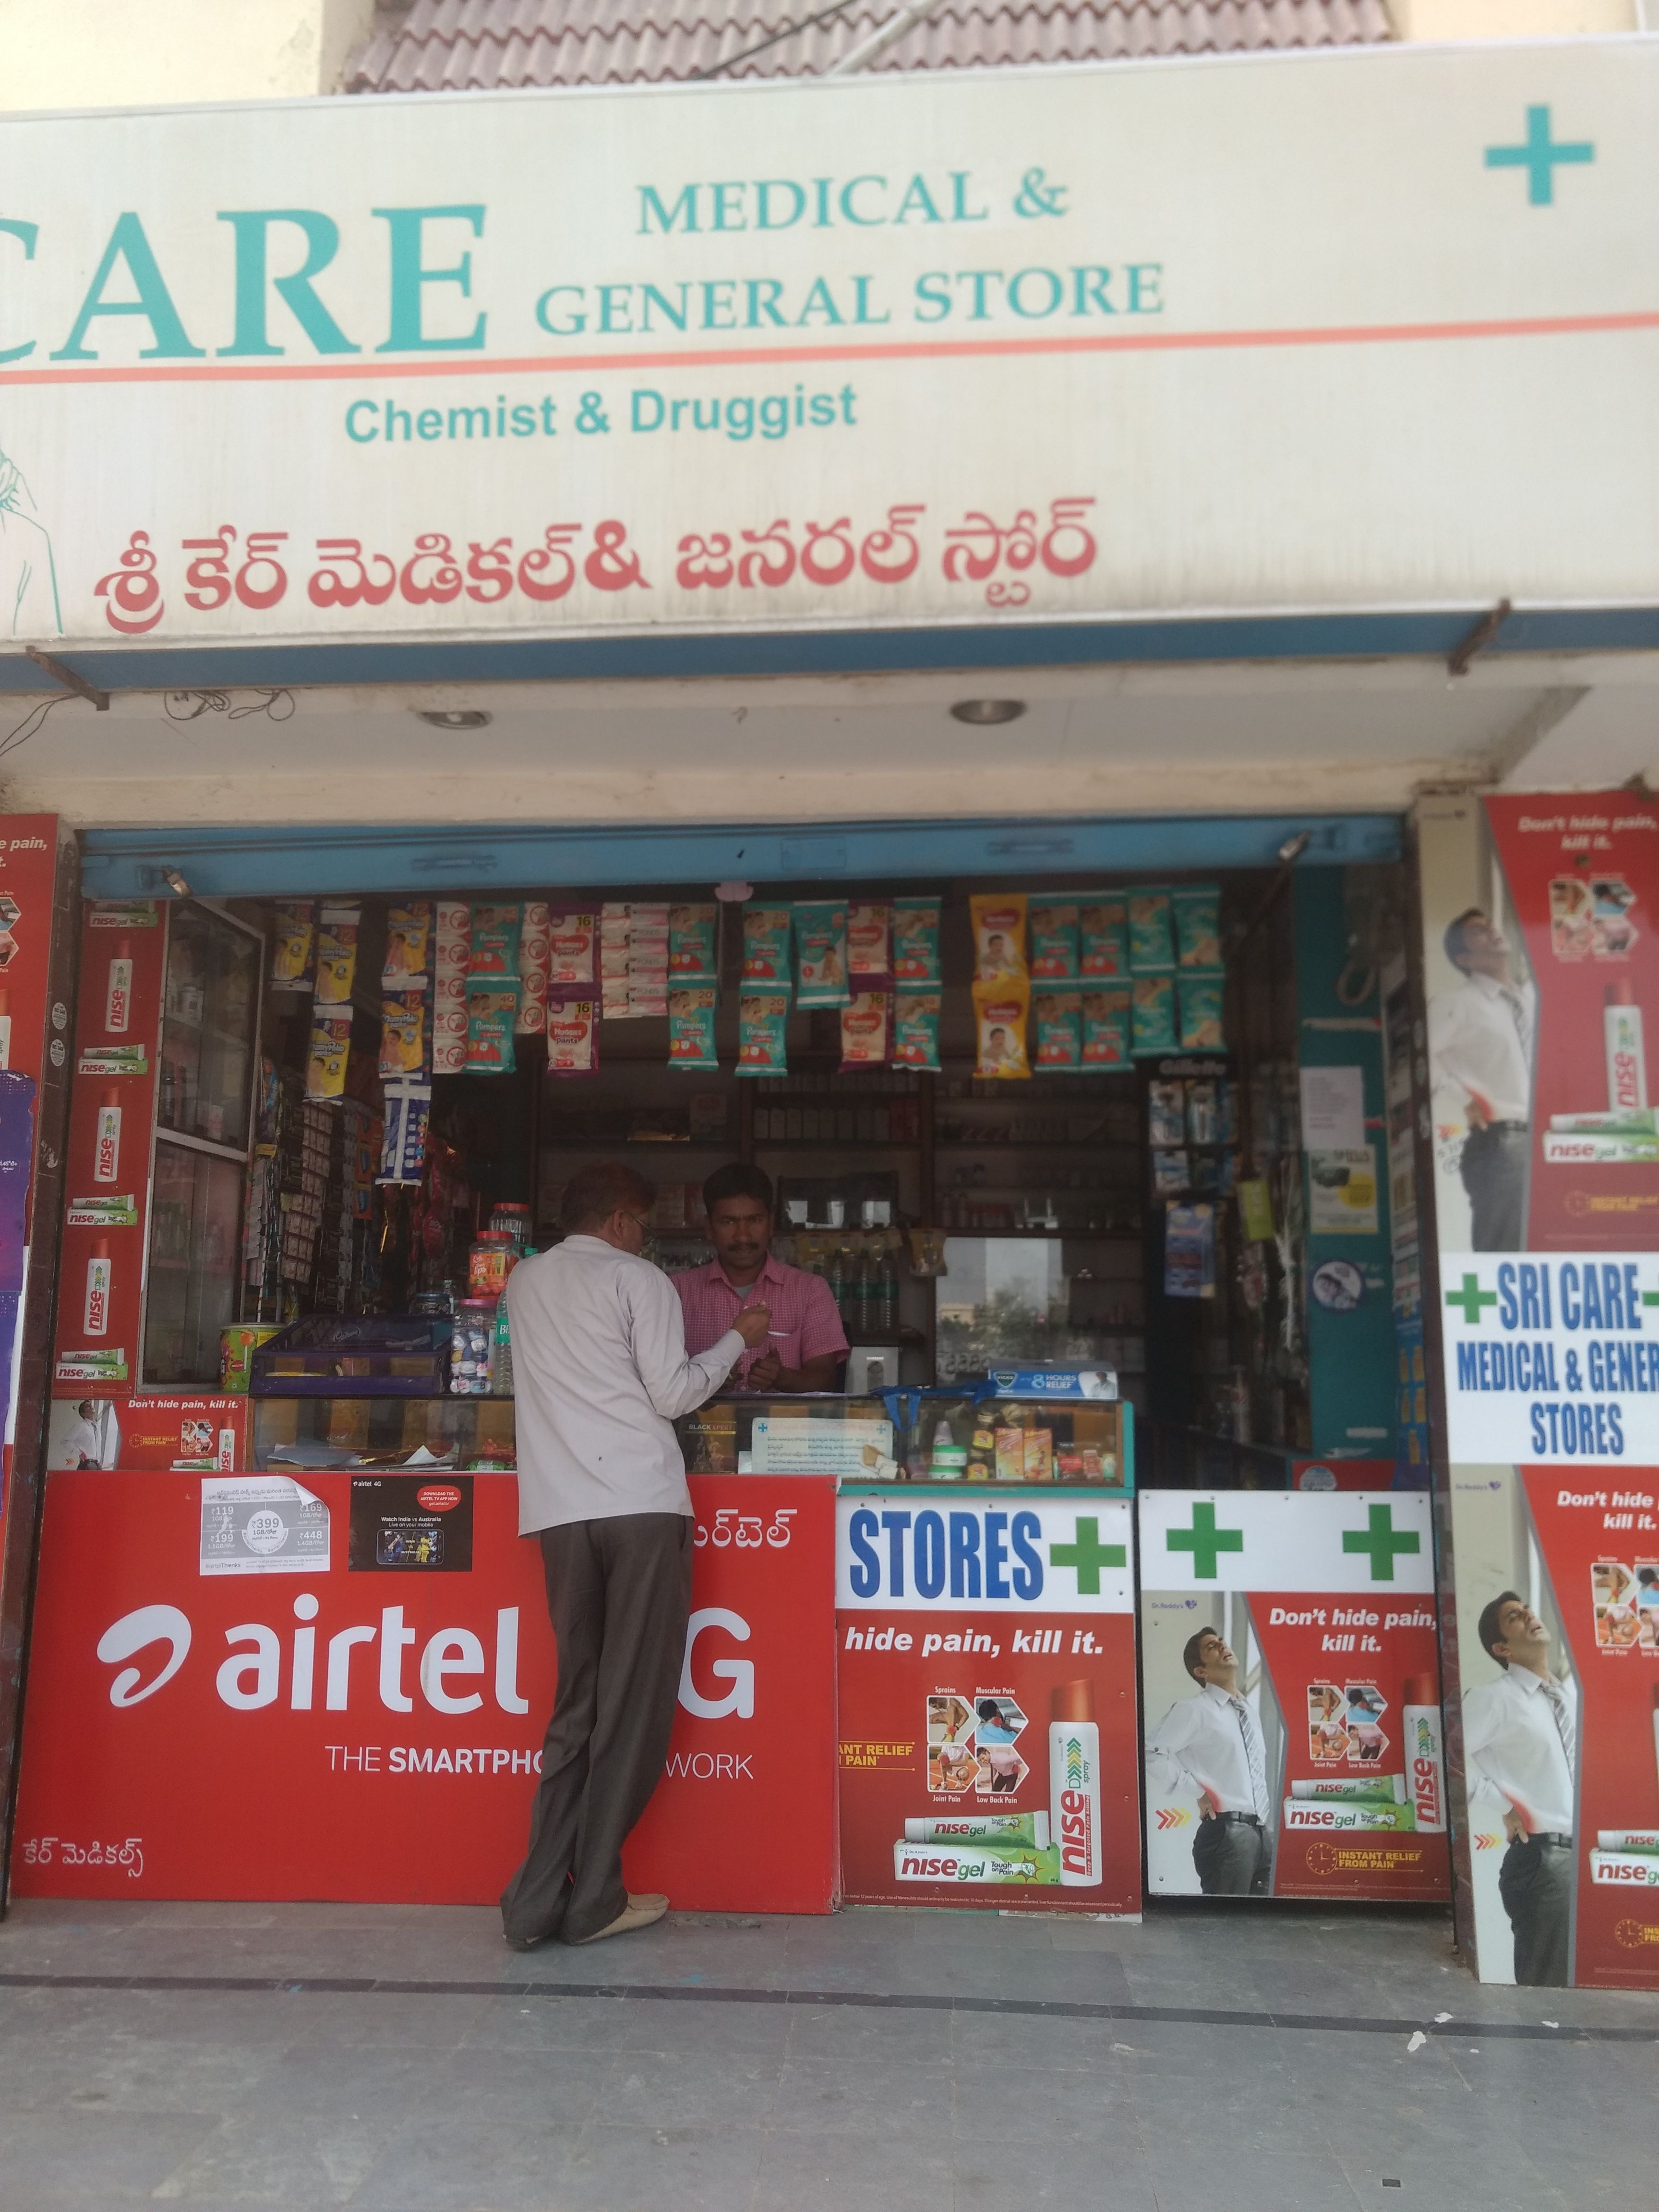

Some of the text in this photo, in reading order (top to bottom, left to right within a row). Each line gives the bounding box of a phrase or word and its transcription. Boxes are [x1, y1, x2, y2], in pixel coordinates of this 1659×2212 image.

[635, 166, 1070, 235] MEDICAL &
[535, 263, 1165, 337] GENERAL STORE
[345, 385, 857, 443] Chemist & Druggist
[94, 530, 164, 634] శ్రీ
[182, 524, 289, 611] కేర్
[676, 505, 926, 589] జనరల్
[942, 497, 1097, 608] స్టోర్
[10, 836, 48, 852] pain,
[92, 916, 116, 925] nise
[578, 916, 591, 926] 16
[407, 994, 420, 1008] 12
[870, 994, 883, 1004] 16
[110, 989, 124, 1027] nise
[577, 1003, 590, 1013] 16
[333, 1023, 347, 1037] 12
[476, 1021, 505, 1031] Pampers
[676, 1020, 706, 1030] Pampers
[747, 1026, 776, 1036] Pampers
[81, 1064, 105, 1072] nise
[1615, 1052, 1638, 1108] nise
[99, 1138, 112, 1177] nise
[1551, 1143, 1595, 1157] nise
[70, 1214, 106, 1224] nise gel
[1498, 1262, 1642, 1330] SRI CARE
[88, 1290, 102, 1330] nise
[58, 1369, 96, 1378] nise gel
[1456, 1340, 1659, 1392] MEDICAL & GENER
[1031, 1374, 1045, 1389] 8
[128, 1399, 238, 1410] Don't hide pain, kill it.
[1530, 1402, 1624, 1455] STORES
[1557, 1490, 1654, 1508] Don't hide
[251, 1518, 279, 1528] ₹399
[1603, 1513, 1657, 1530] kill it.
[299, 1530, 323, 1539] ₹448
[849, 1508, 1044, 1600] STORES
[1269, 1608, 1436, 1630] Don't hide pain,
[845, 1626, 1103, 1658] hide pain, kill it.
[1322, 1634, 1381, 1652] kill it.
[216, 1593, 755, 1719] airtel G
[866, 1744, 914, 1756] RELIEF
[325, 1745, 754, 1780] THE SMARTPH WORK
[846, 1755, 878, 1766] PAIN
[1315, 1783, 1356, 1795] nise gel
[1413, 1757, 1436, 1824] nise
[1290, 1811, 1357, 1829] nise gel
[935, 1823, 986, 1837] nise gel
[1060, 1790, 1085, 1876] nise
[1624, 1834, 1655, 1845] nise
[23, 1837, 58, 1863] కేర్
[1338, 1851, 1421, 1861] INSTANT RELIEF
[901, 1858, 986, 1880] nise gel
[1339, 1859, 1395, 1868] FROM PAIN
[1598, 1863, 1647, 1880] nise
